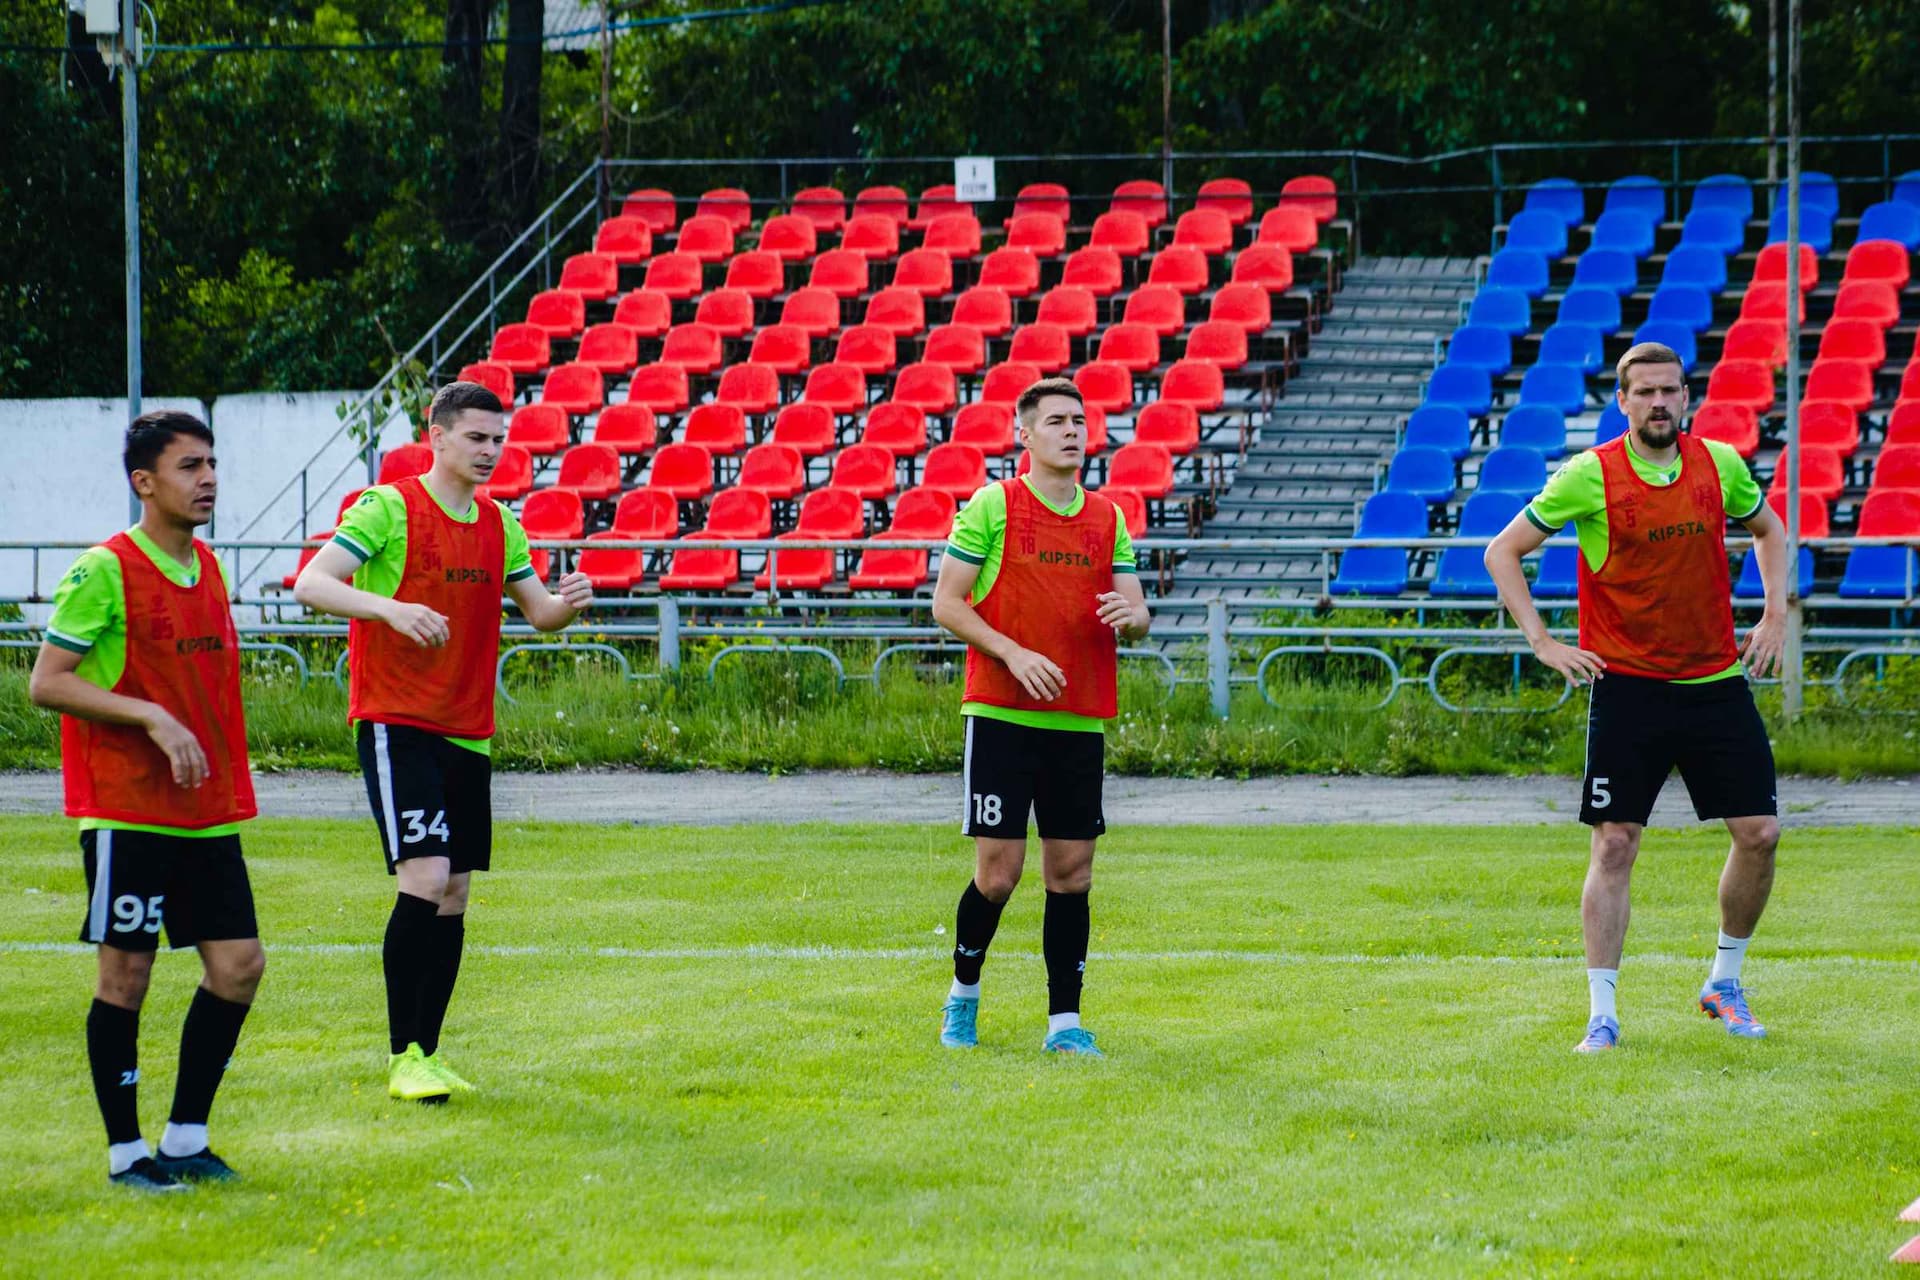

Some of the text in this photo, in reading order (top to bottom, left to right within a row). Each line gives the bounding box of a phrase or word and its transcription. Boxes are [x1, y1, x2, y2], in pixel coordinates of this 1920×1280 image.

[1647, 521, 1706, 544] KIPSTA
[1039, 549, 1092, 568] KIPSTA
[445, 567, 493, 584] KIPSTA
[176, 635, 224, 656] KIPSTA
[1591, 777, 1612, 809] 5
[972, 793, 1003, 827] 18
[401, 809, 450, 844] 34
[112, 894, 165, 934] 95
